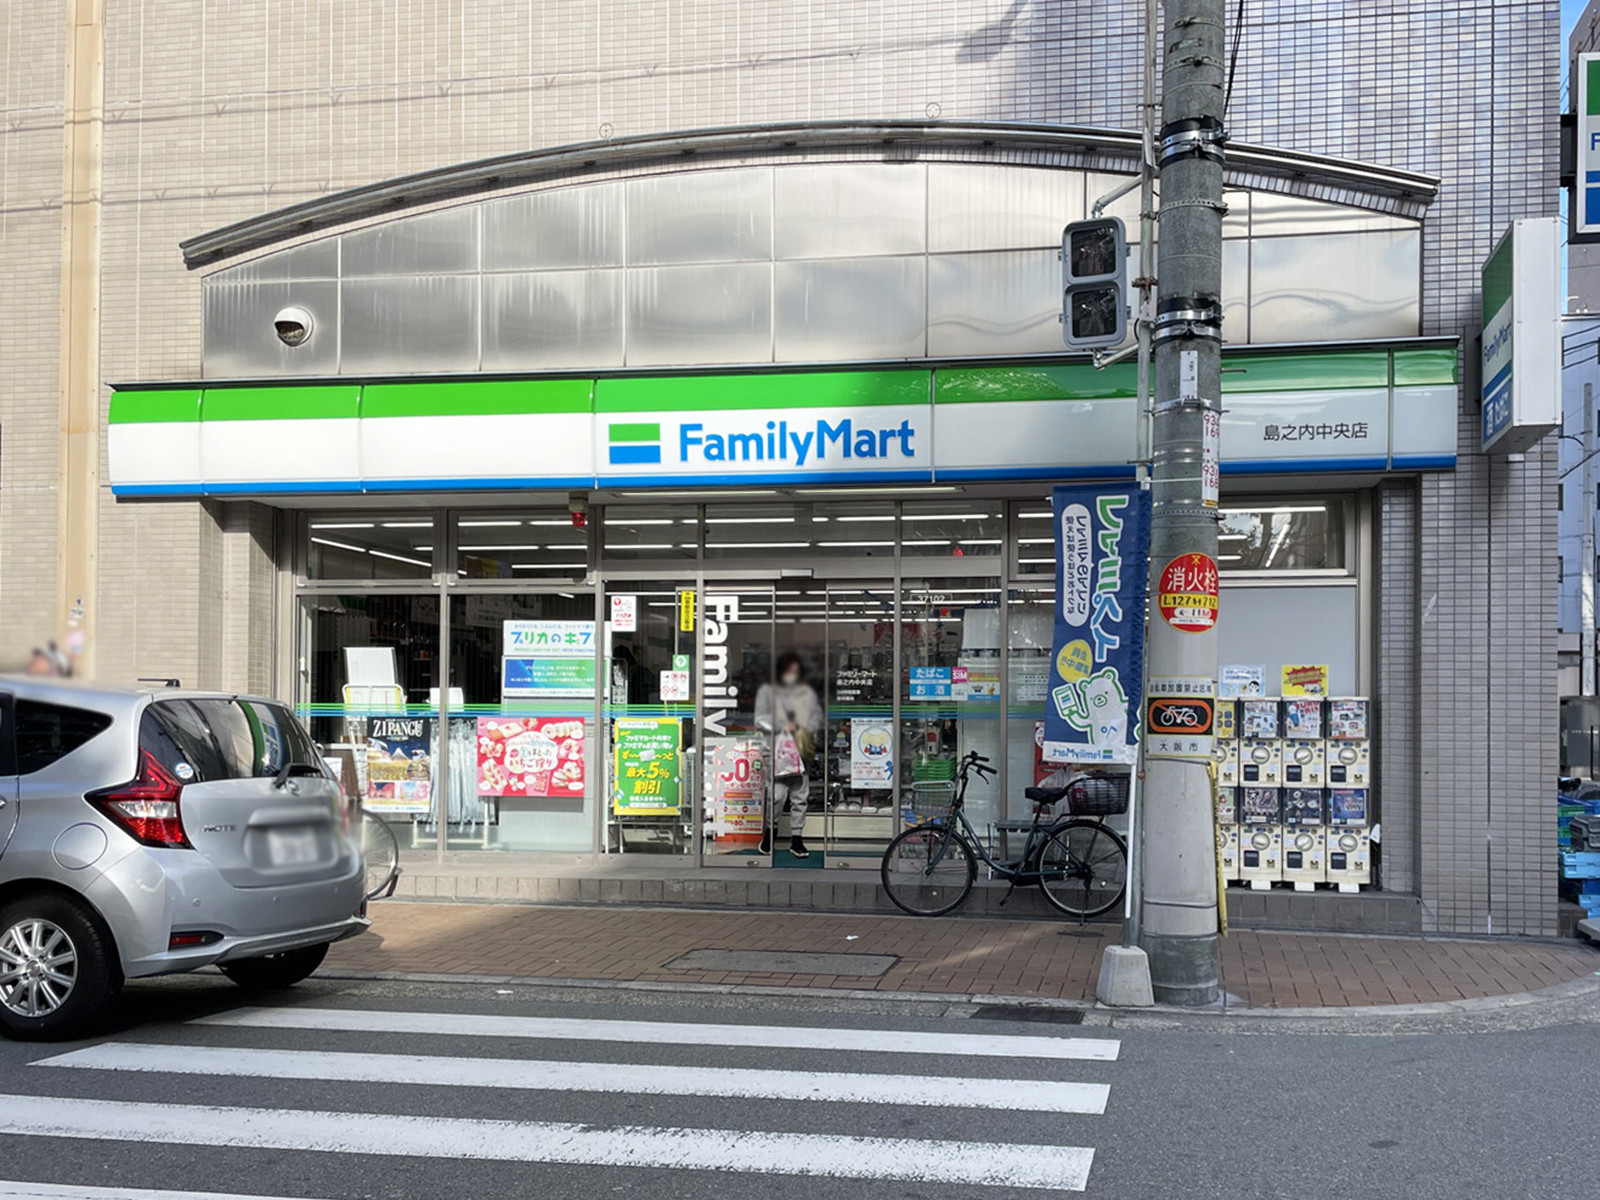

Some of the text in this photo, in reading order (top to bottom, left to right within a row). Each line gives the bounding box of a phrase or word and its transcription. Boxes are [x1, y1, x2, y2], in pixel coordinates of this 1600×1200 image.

[1263, 422, 1368, 441] 島之内中央店
[679, 419, 915, 466] FamilyMart
[1167, 566, 1217, 593] 消火栓
[836, 668, 877, 677] ファミリーマート
[916, 667, 944, 678] たばこ
[952, 672, 968, 680] SIM
[372, 719, 424, 737] ZIPANGU
[1160, 743, 1198, 752] 大阪市
[633, 780, 661, 795] 割引
